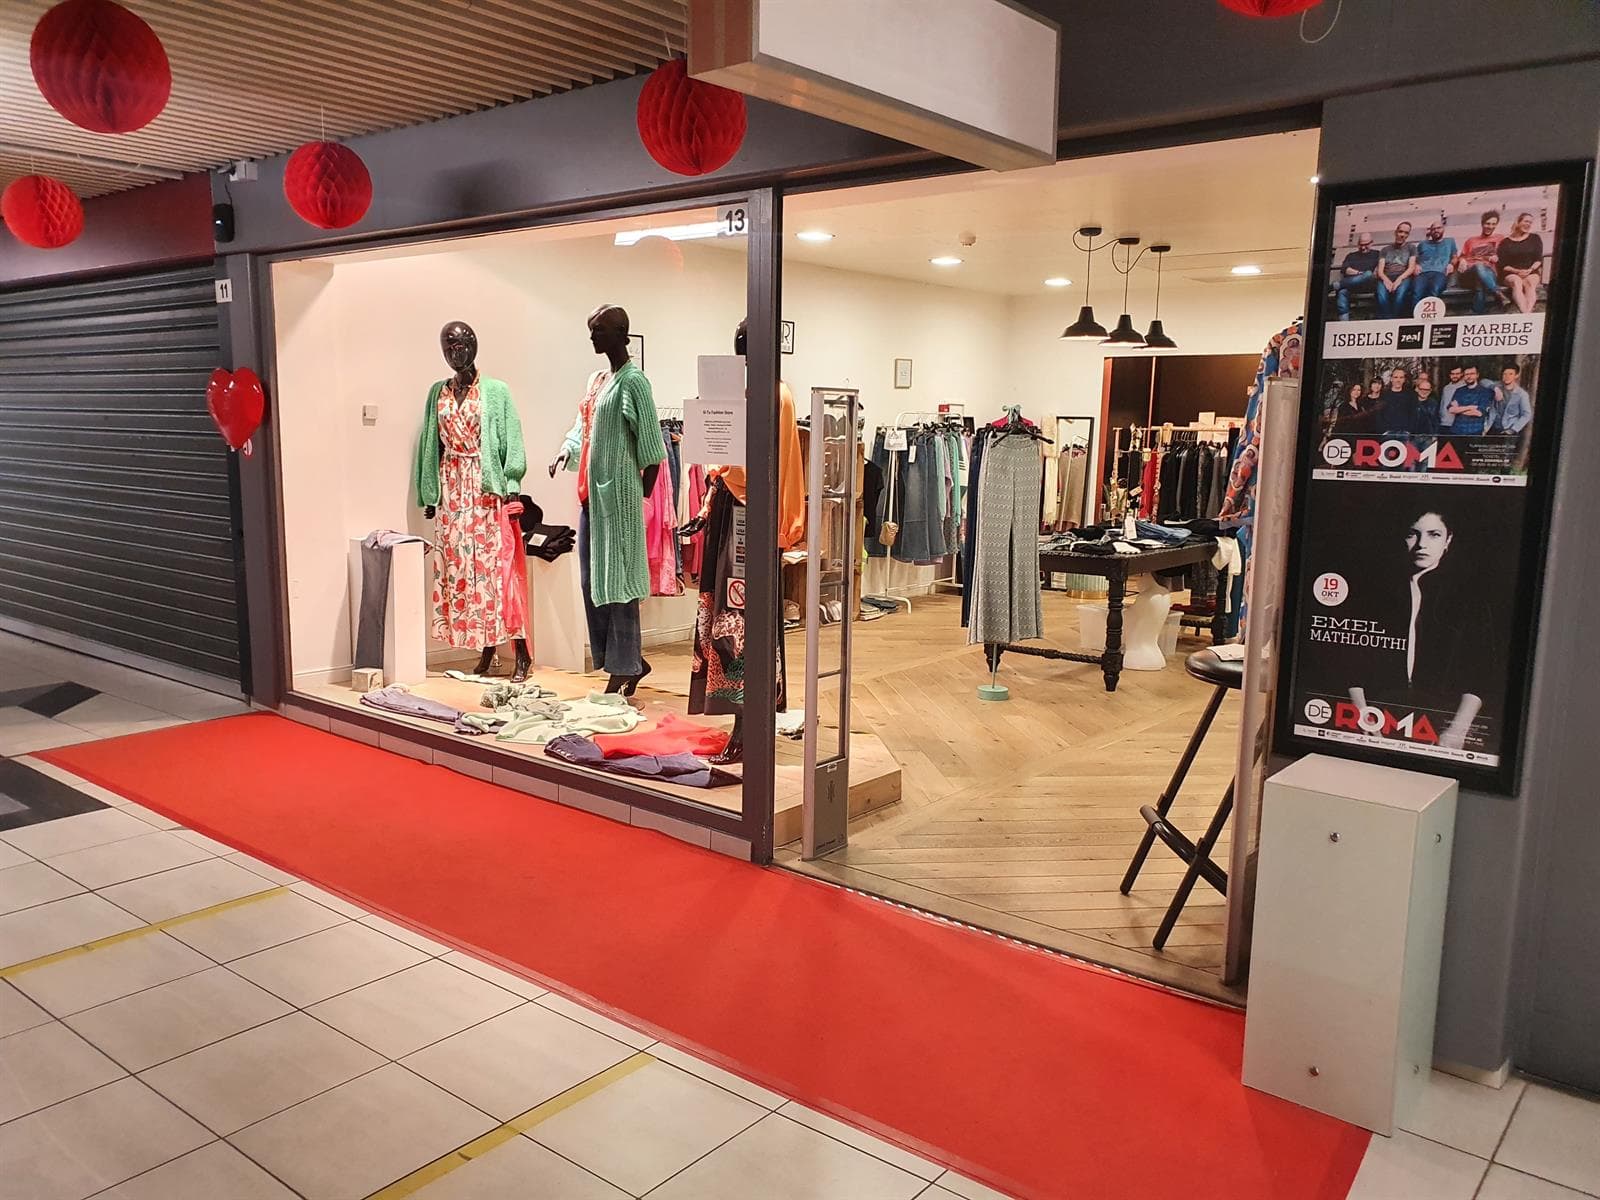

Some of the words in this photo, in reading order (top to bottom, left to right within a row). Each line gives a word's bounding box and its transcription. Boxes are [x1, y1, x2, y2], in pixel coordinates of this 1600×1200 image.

[725, 208, 745, 232] 13
[219, 283, 228, 298] 11
[1423, 301, 1437, 312] 21
[1463, 322, 1533, 336] MARBLE
[1332, 332, 1394, 348] ISBELLS
[1461, 335, 1529, 348] SOUNDS
[1326, 445, 1350, 459] DE
[1353, 439, 1465, 469] ROMA
[1323, 577, 1338, 591] 19
[1321, 590, 1340, 598] OKT
[1311, 615, 1386, 635] EMEL
[1310, 629, 1407, 651] MATHLOUTHI
[1308, 704, 1332, 720] DE
[1334, 702, 1440, 745] ROMA
